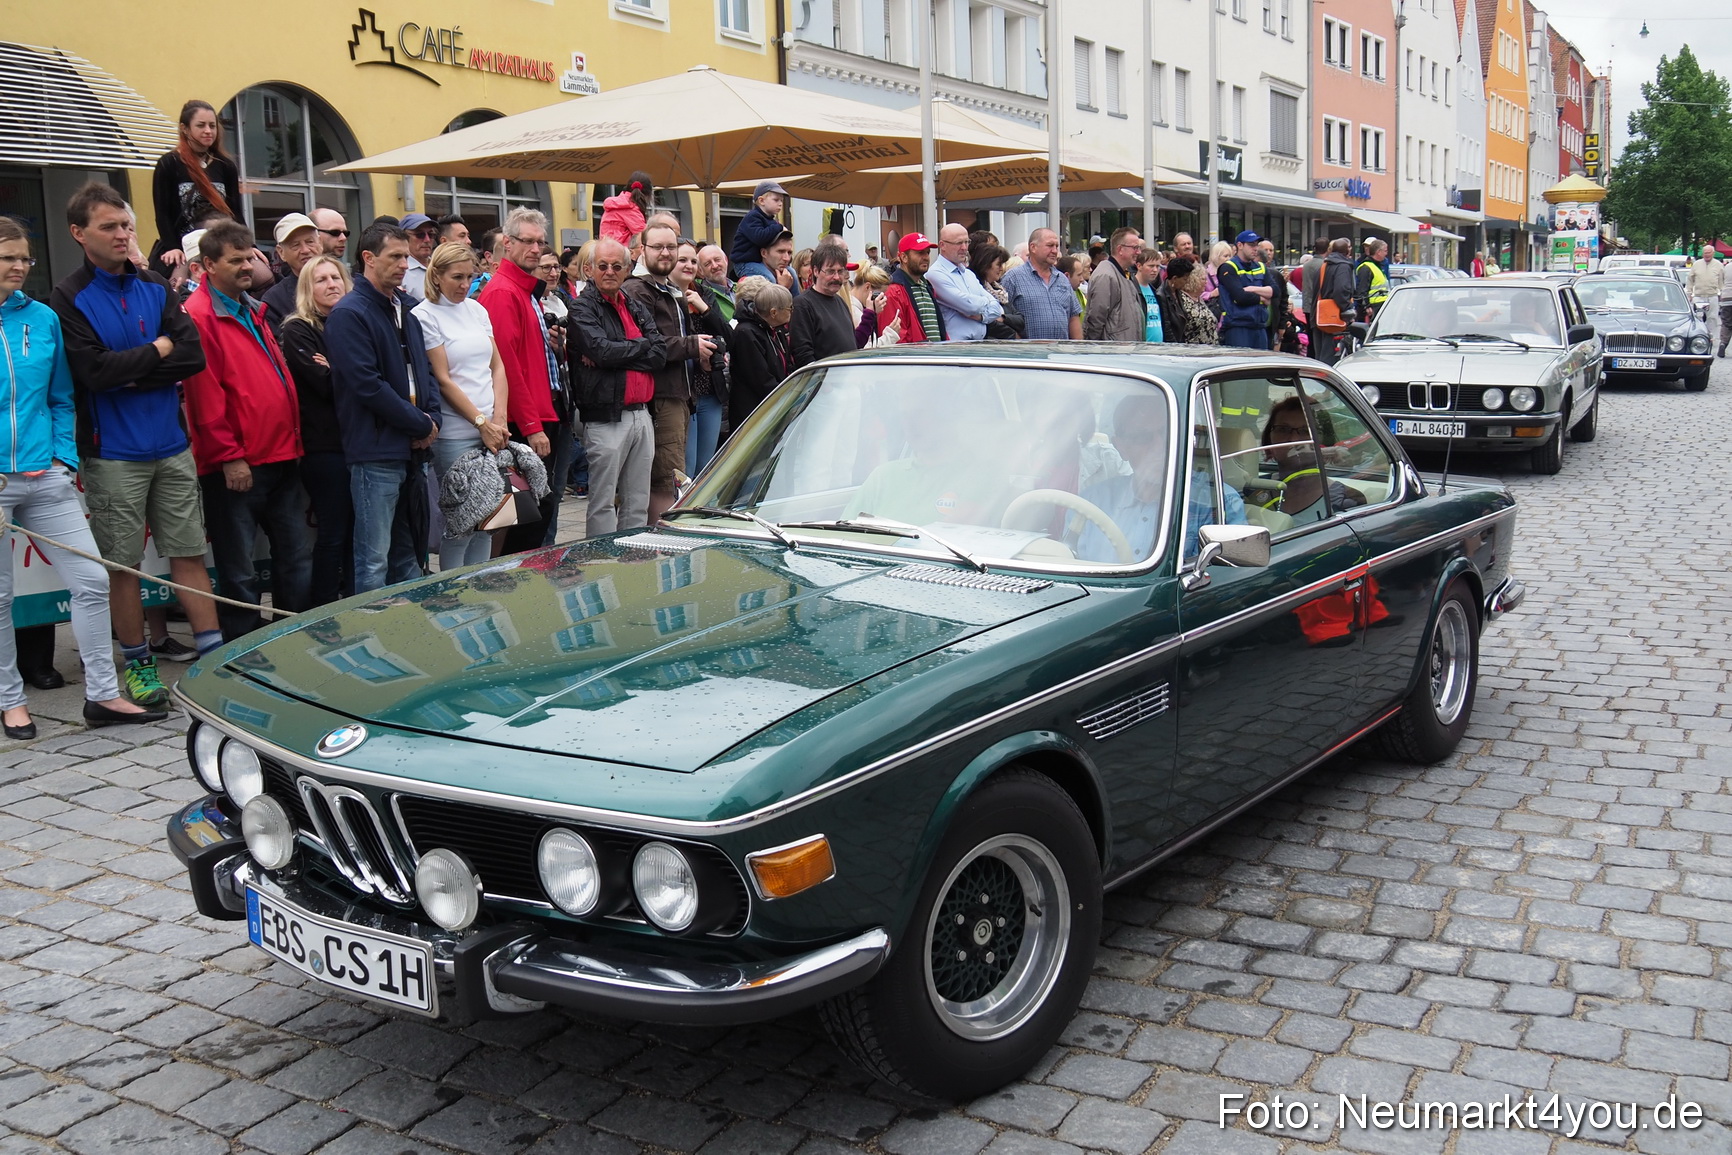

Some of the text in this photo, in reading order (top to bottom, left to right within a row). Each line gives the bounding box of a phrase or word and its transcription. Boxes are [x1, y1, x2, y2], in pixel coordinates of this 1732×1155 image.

[399, 22, 556, 83] CAFÉ AM RATHAUS
[1396, 422, 1404, 433] B
[1411, 422, 1425, 434] AL
[260, 902, 306, 964] EBS
